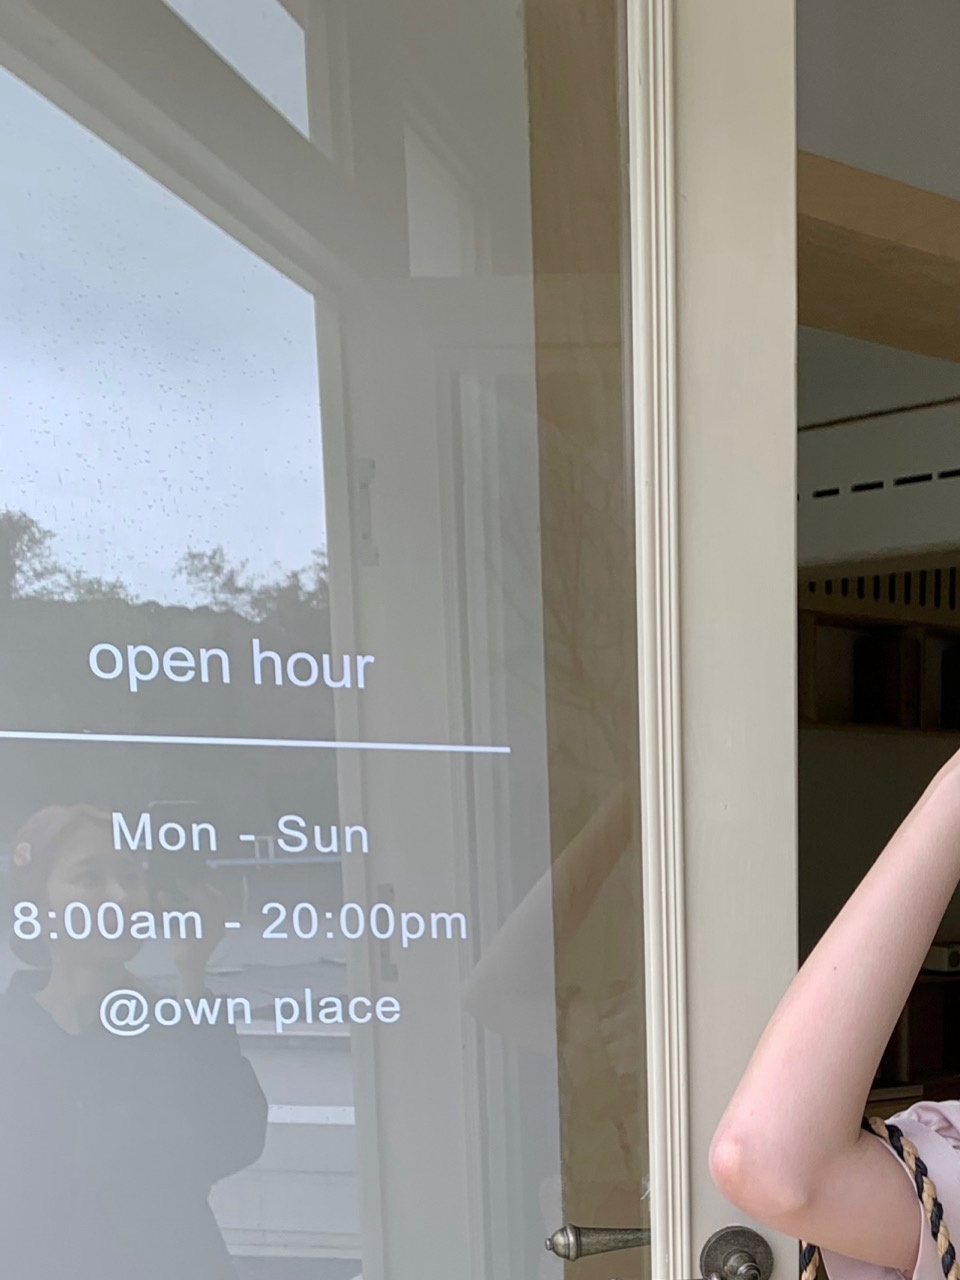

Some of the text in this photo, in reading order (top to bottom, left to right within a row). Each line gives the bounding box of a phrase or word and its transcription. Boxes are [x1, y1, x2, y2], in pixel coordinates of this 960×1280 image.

[88, 638, 375, 692] open hour
[111, 812, 217, 852] Mon
[277, 814, 369, 853] Sun
[13, 901, 203, 939] 8:00am
[261, 902, 467, 947] 20:00pm
[99, 988, 401, 1036] @own place
